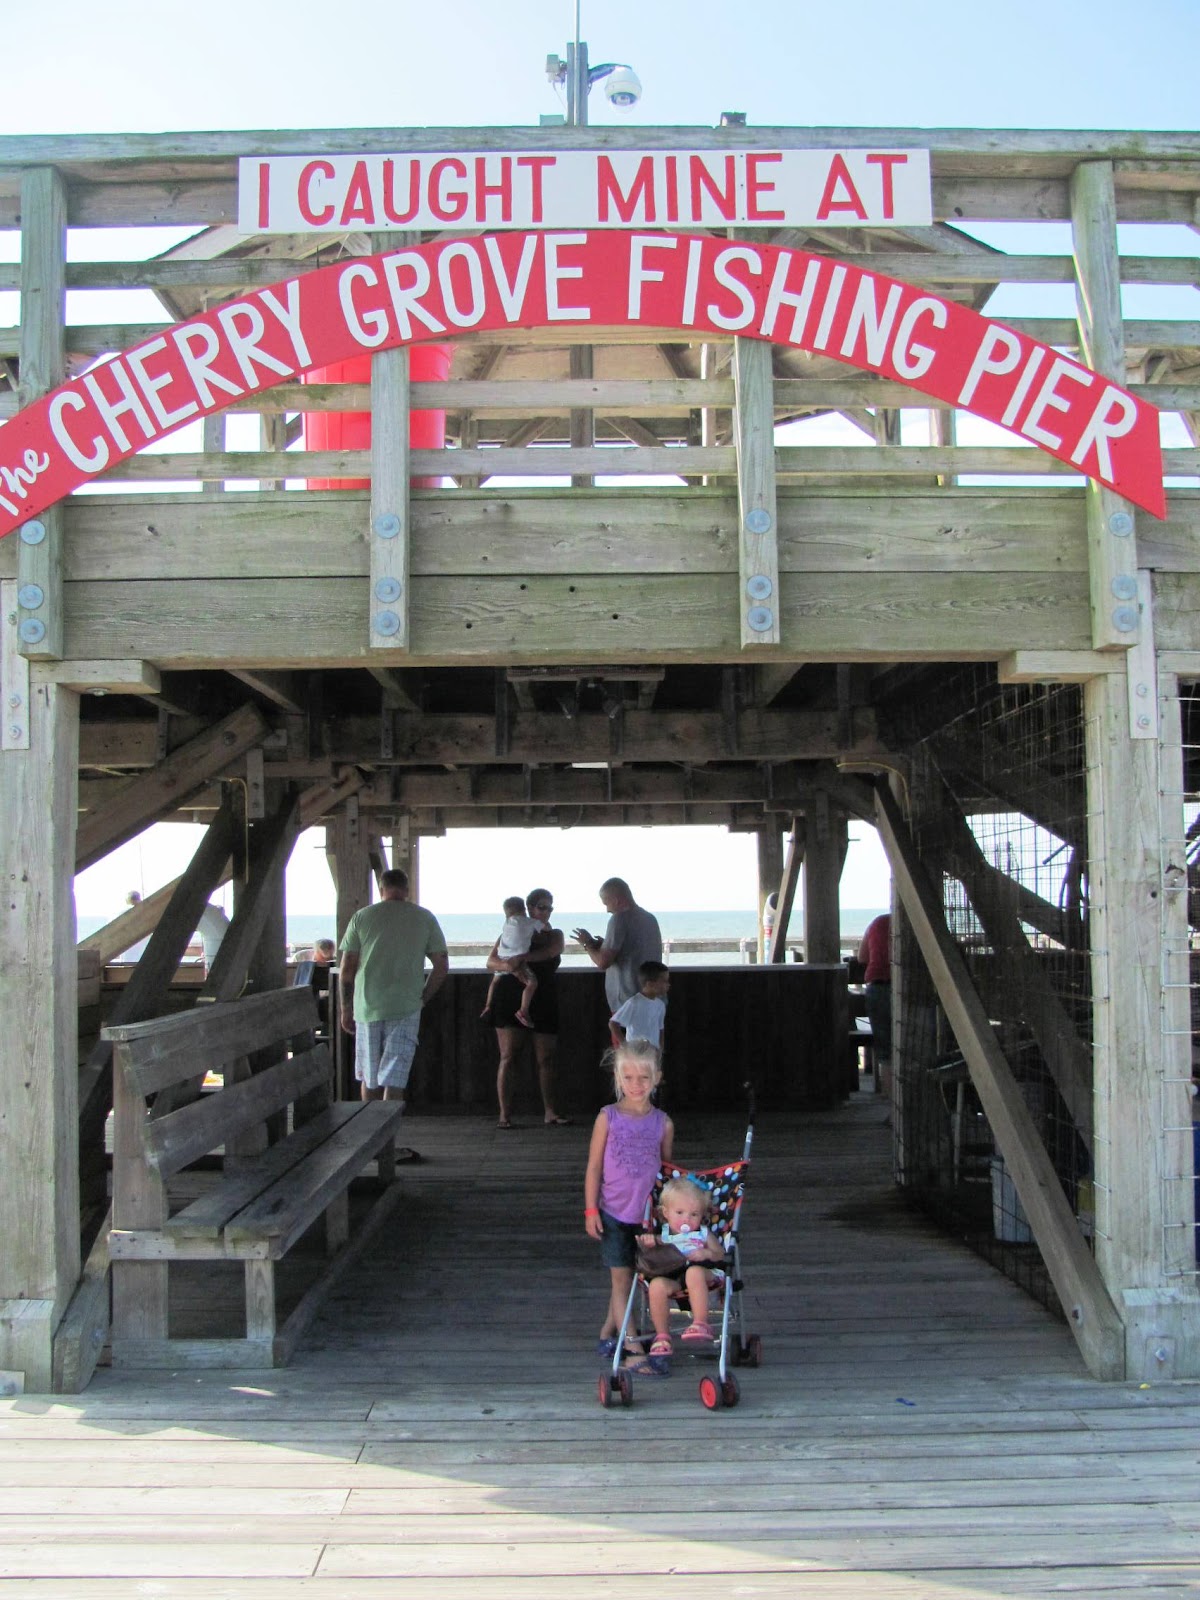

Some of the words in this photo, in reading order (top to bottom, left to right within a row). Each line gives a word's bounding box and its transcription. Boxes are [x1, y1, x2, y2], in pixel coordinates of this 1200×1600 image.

[259, 163, 270, 228] I
[298, 156, 556, 226] CAUGHT
[597, 153, 785, 223] MINE
[816, 153, 908, 220] AT
[48, 280, 312, 474] CHERRY
[338, 233, 591, 348] GROVE
[627, 235, 947, 380] FISHING
[957, 323, 1138, 484] PIER
